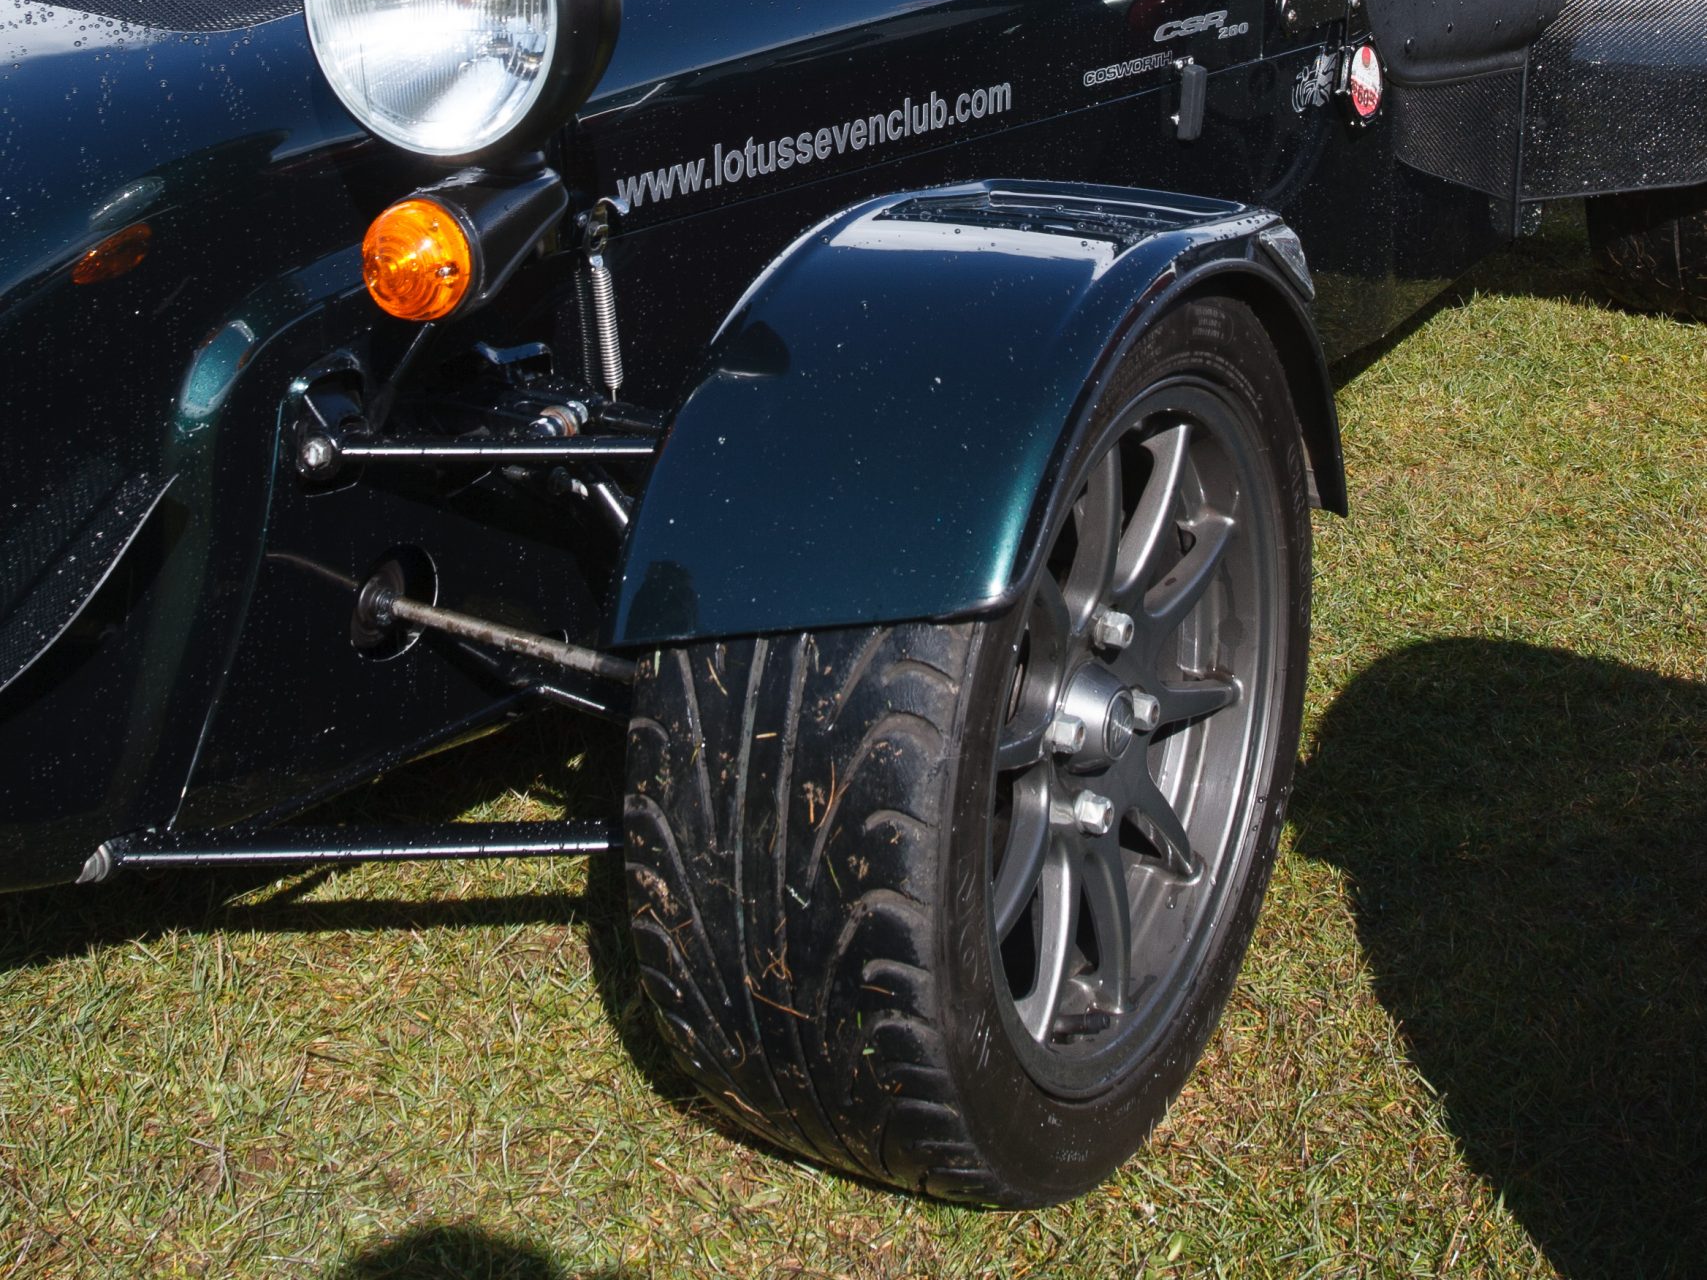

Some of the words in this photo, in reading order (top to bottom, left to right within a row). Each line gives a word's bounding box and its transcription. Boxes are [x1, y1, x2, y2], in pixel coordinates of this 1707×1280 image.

[1154, 10, 1228, 42] CSR
[1217, 22, 1249, 40] 260
[1083, 50, 1173, 87] COSWORTH
[616, 81, 1012, 209] www.lotussevenclub.com
